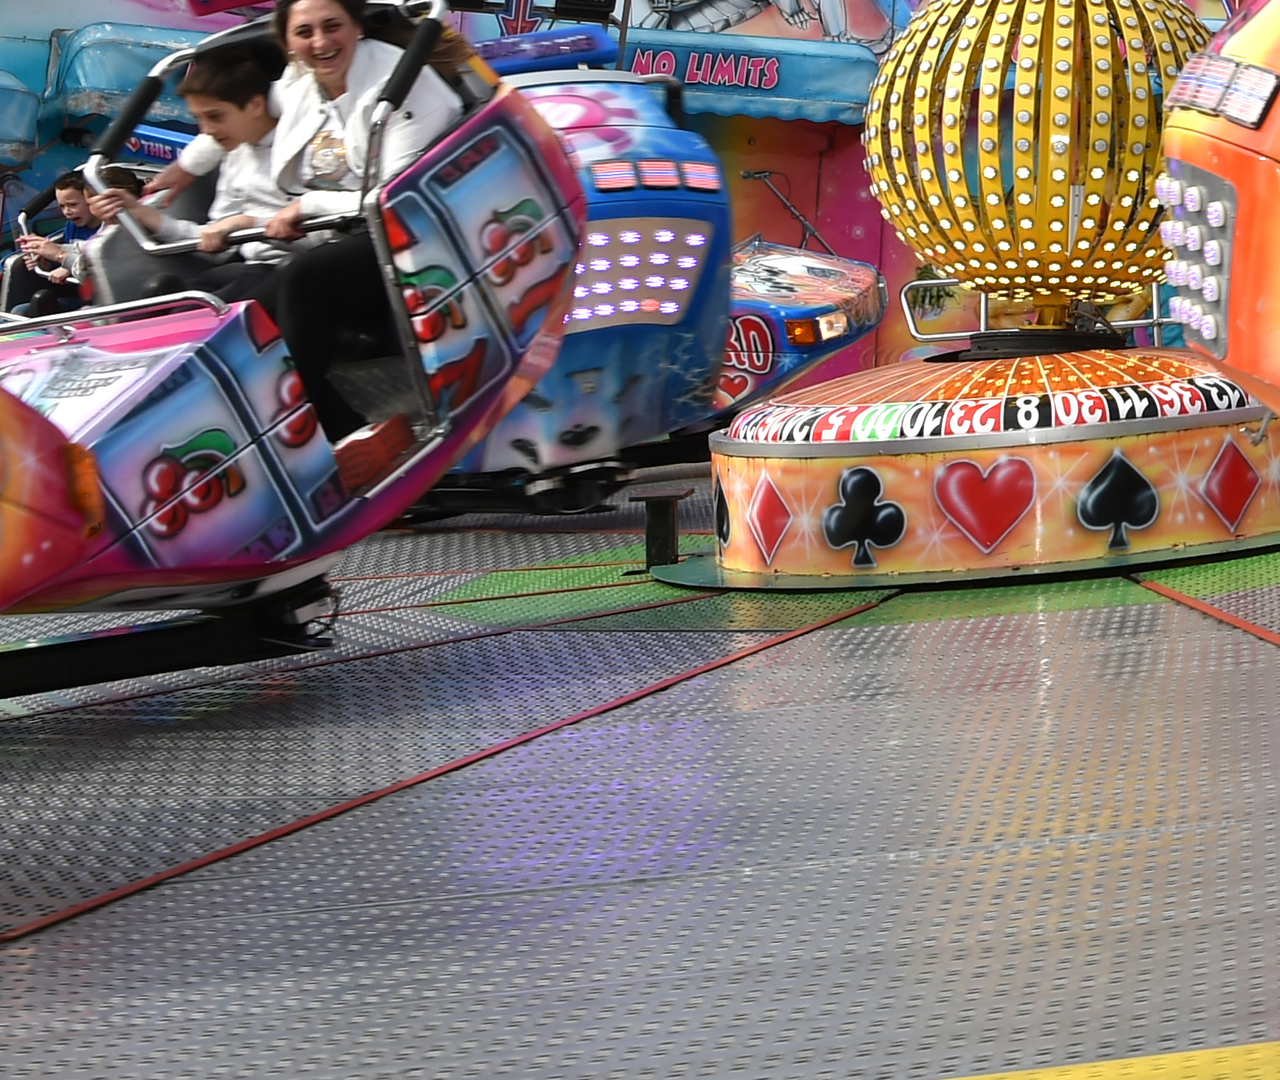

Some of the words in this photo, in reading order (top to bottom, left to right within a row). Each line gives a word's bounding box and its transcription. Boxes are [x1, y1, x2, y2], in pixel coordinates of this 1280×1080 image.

[631, 48, 676, 76] NO
[684, 51, 779, 90] LIMITS
[140, 140, 173, 160] THIS
[1017, 397, 1040, 430] 8
[1055, 391, 1102, 425] 30
[1109, 386, 1151, 418] 11
[1160, 382, 1202, 416] 36
[821, 406, 850, 441] 5
[902, 403, 945, 438] 10
[949, 402, 996, 434] 23
